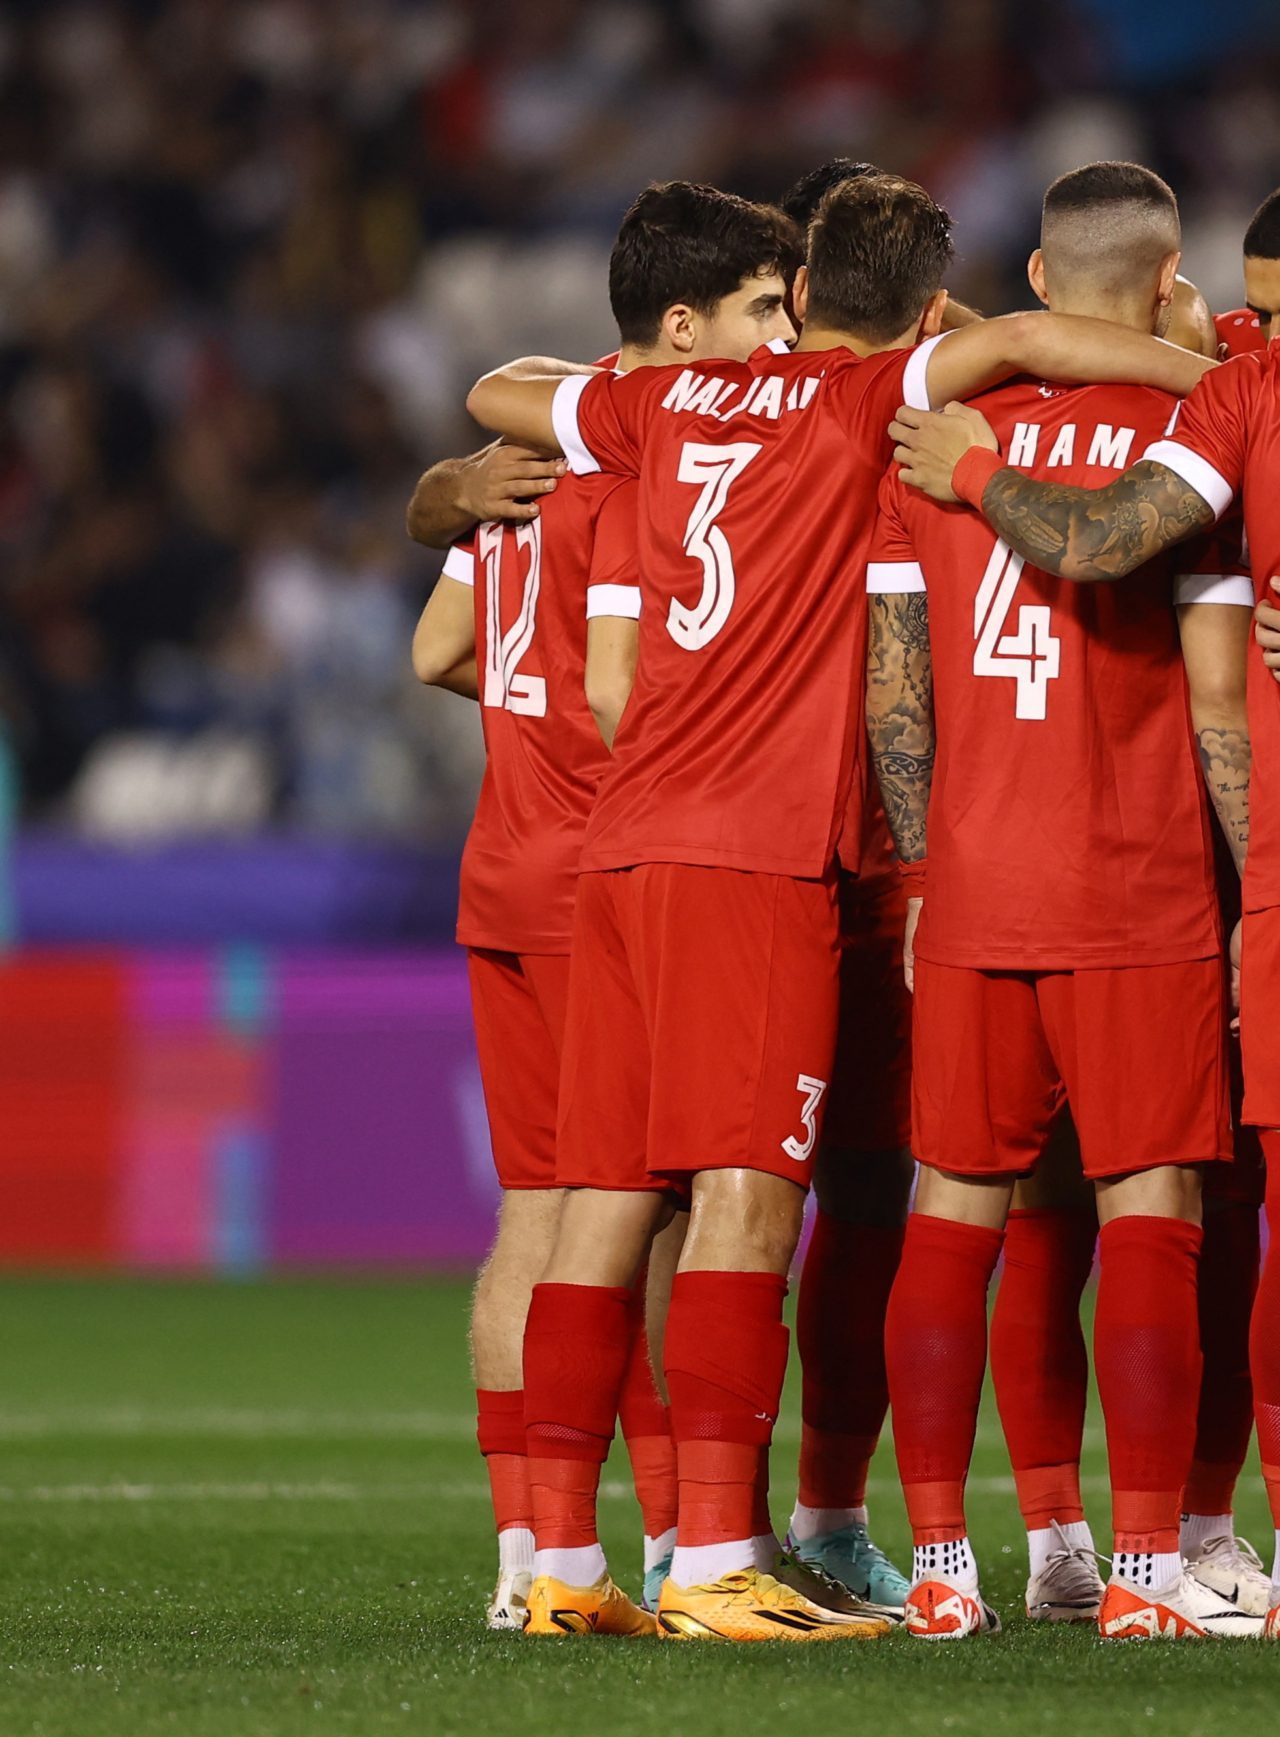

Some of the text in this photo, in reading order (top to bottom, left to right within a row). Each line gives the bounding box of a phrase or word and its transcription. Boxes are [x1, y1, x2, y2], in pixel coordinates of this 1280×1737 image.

[478, 513, 548, 718] 12
[665, 441, 764, 652] 3
[973, 535, 1060, 720] 4
[781, 1073, 827, 1161] 3
